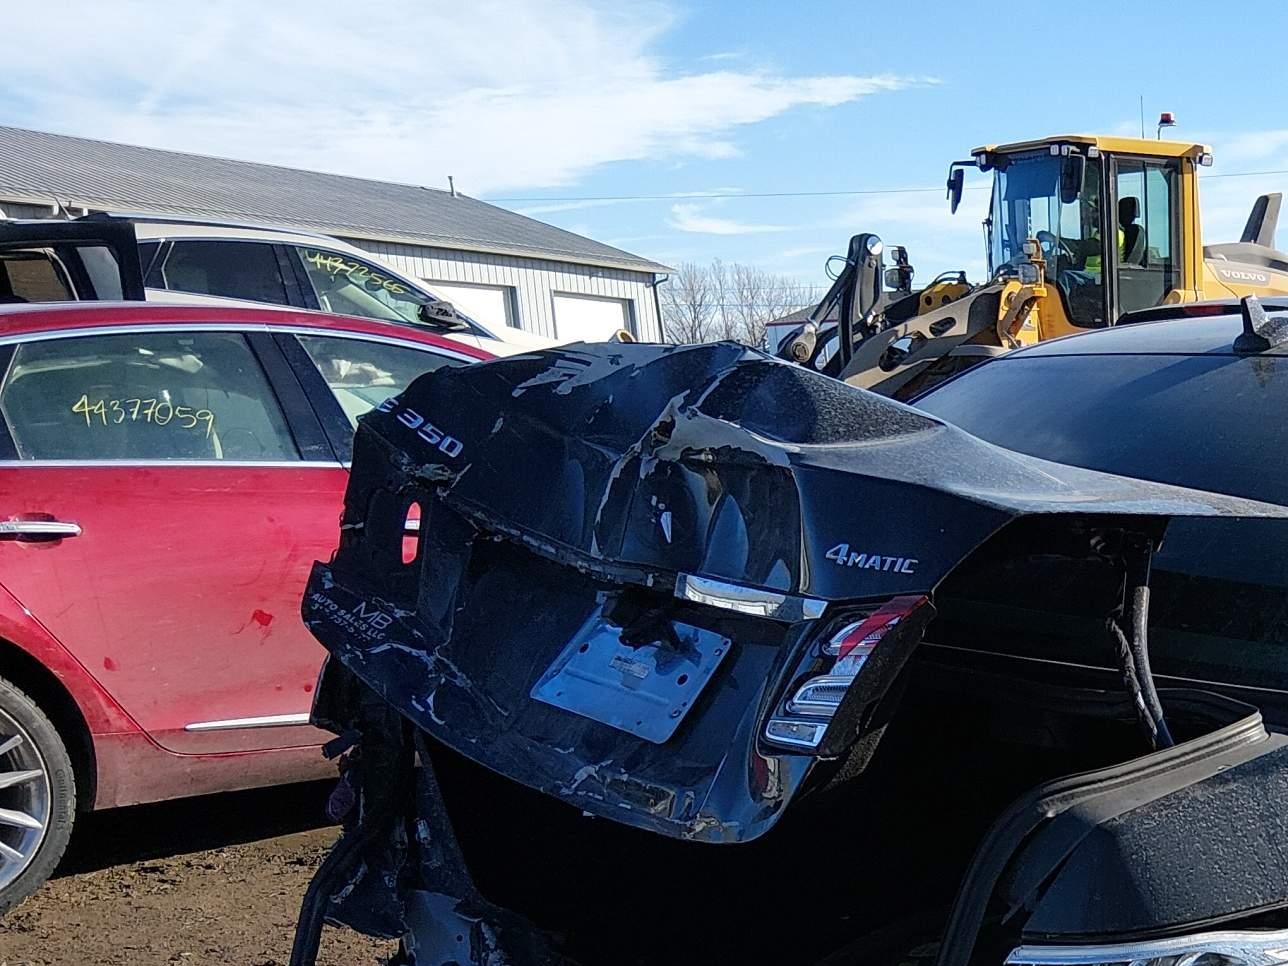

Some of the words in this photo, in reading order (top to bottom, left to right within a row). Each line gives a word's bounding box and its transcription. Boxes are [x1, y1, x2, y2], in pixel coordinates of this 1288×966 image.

[1221, 269, 1266, 281] VOLVO
[71, 394, 214, 439] 44377059
[396, 407, 464, 458] 350
[825, 543, 919, 574] 4MATIC
[311, 593, 339, 610] AUTO
[336, 608, 369, 631] SALES
[352, 601, 393, 630] MB
